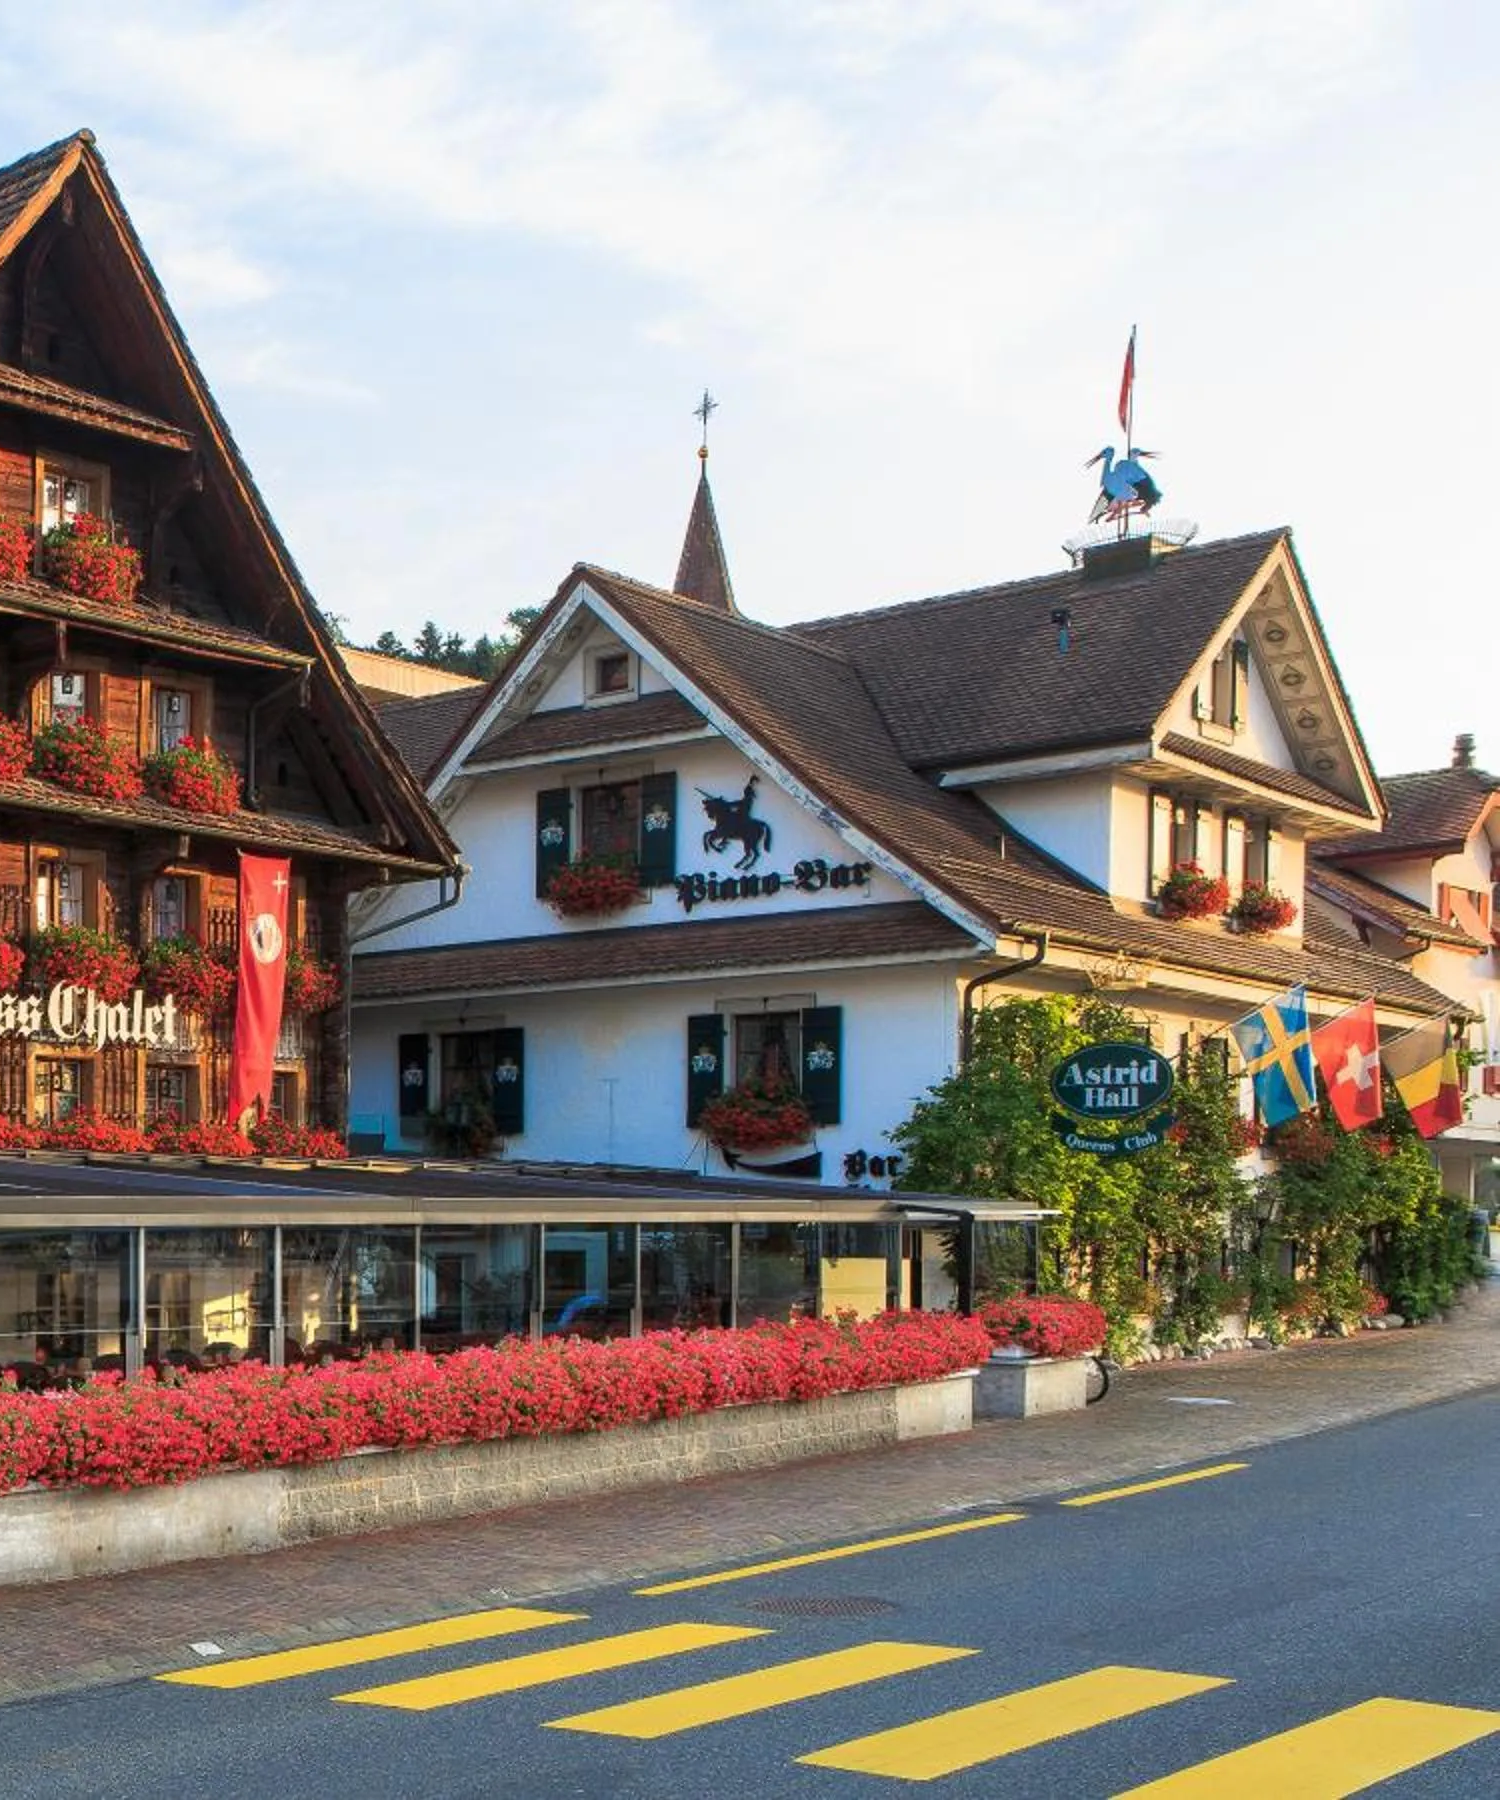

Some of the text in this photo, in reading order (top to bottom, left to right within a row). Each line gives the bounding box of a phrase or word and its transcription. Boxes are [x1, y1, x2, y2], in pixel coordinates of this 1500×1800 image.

[675, 858, 873, 914] Piano-Bar
[48, 979, 178, 1053] Chalet
[1059, 1058, 1159, 1086] Astrid
[1083, 1086, 1140, 1108] Hall
[1065, 1131, 1158, 1152] Queens Club
[844, 1149, 903, 1181] Bar
